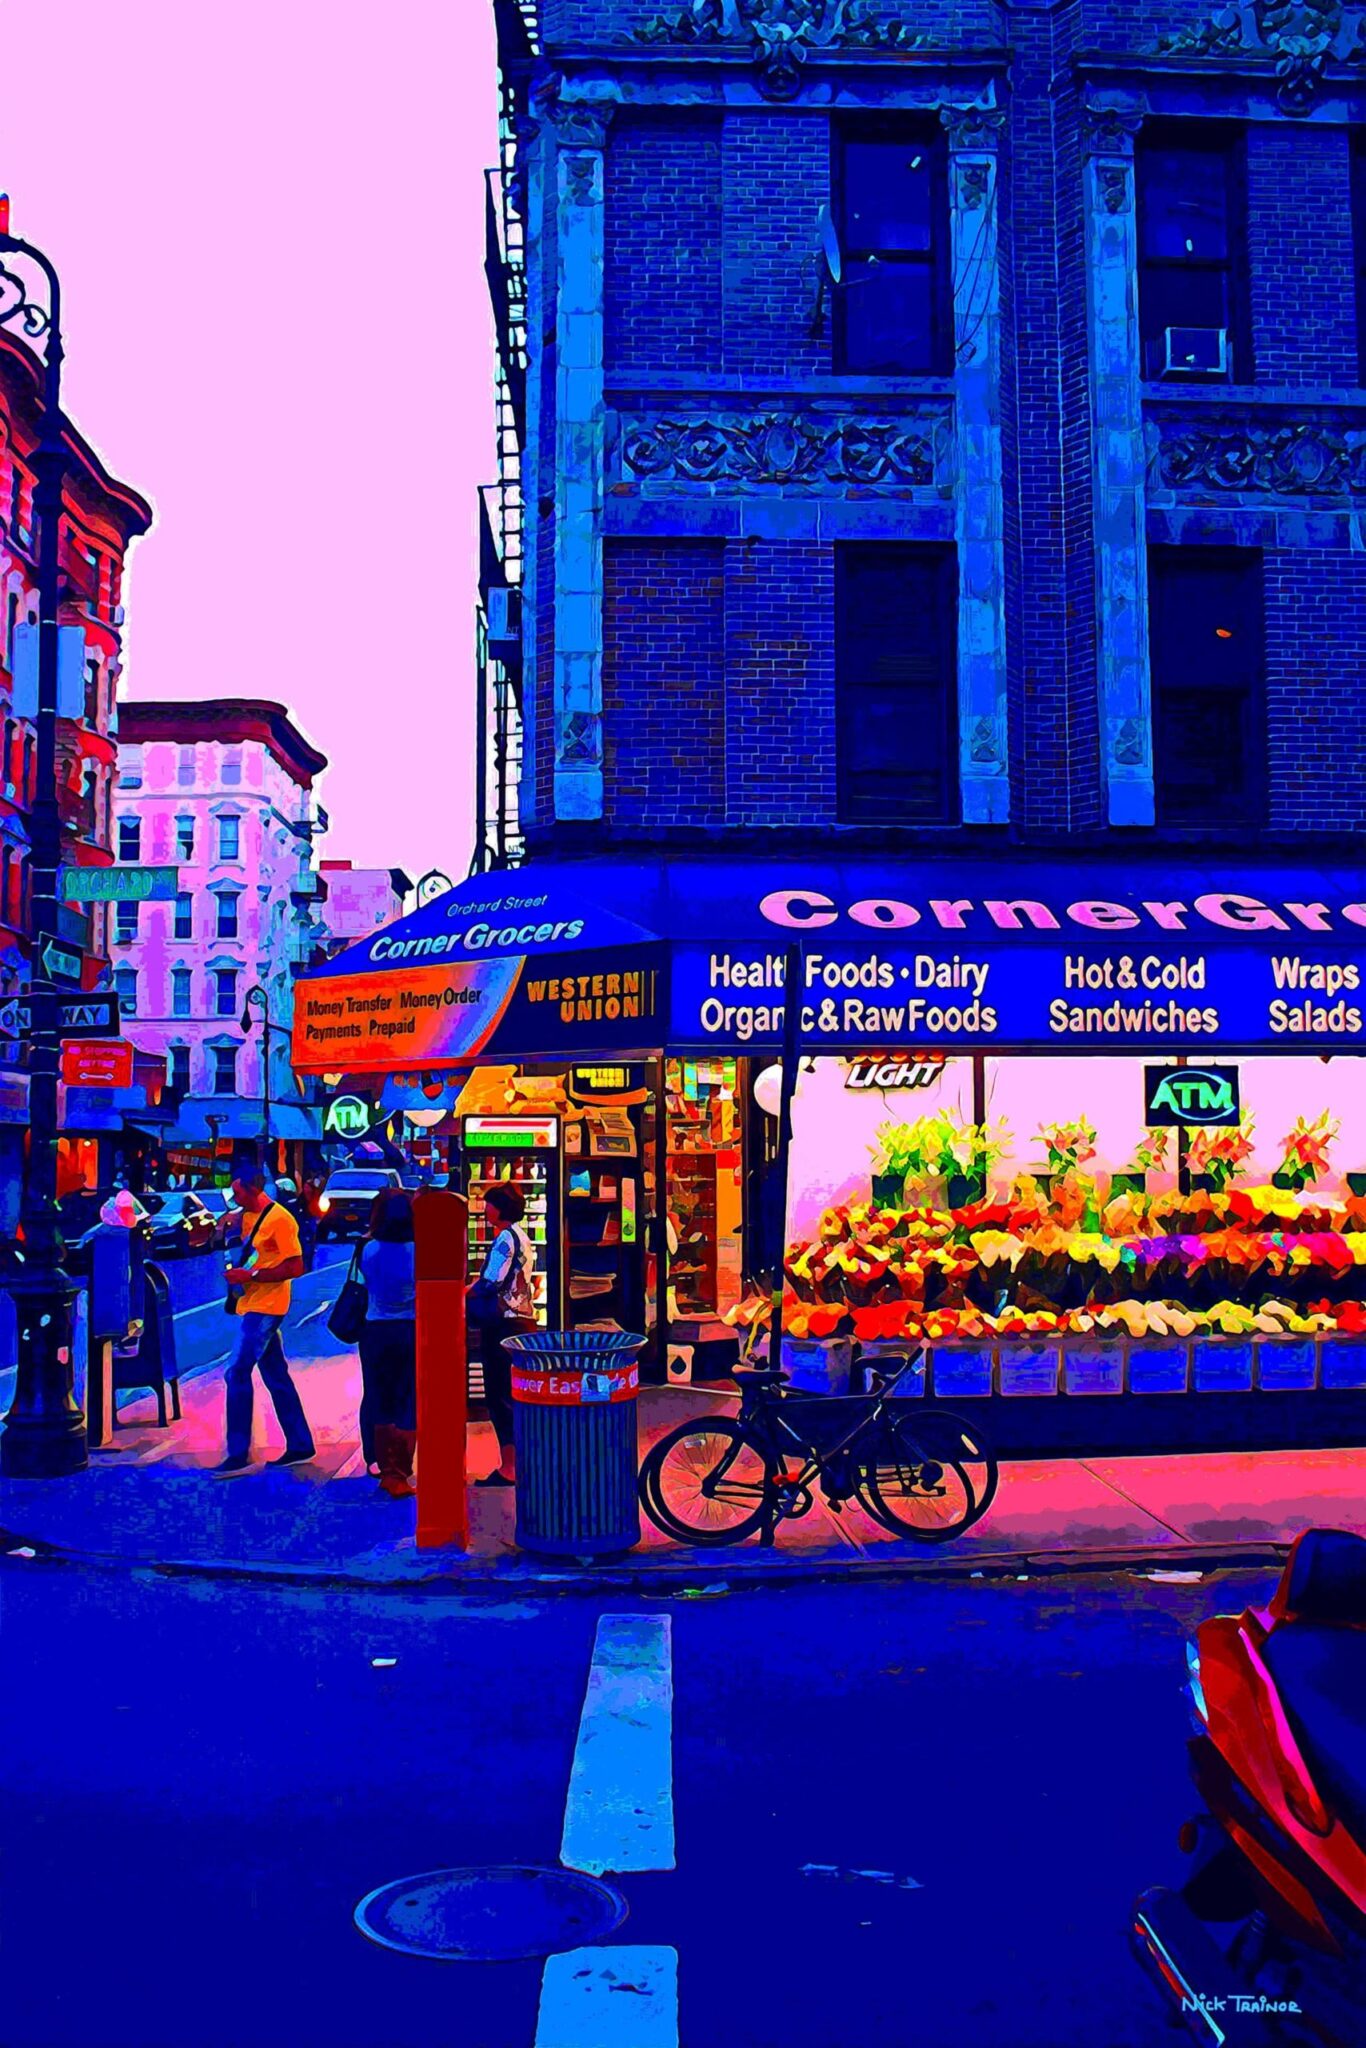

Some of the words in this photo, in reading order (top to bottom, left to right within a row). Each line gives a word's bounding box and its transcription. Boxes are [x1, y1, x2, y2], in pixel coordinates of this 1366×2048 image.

[66, 871, 153, 895] ORCHARD
[447, 898, 501, 917] Orchard
[503, 894, 548, 910] Street
[369, 932, 461, 961] Corner
[464, 919, 585, 950] Grocers
[527, 971, 639, 1002] WESTERN
[711, 955, 787, 987] Healt
[806, 955, 894, 987] Foods
[915, 955, 989, 996] Dairy
[1271, 957, 1359, 997] Wraps
[307, 1000, 344, 1017] Money
[346, 994, 392, 1013] Transfer
[400, 992, 443, 1009] Money
[444, 986, 482, 1005] Order
[560, 996, 639, 1023] UNION
[62, 1007, 99, 1025] WAY
[306, 1024, 361, 1042] Payments
[369, 1017, 415, 1037] Prepaid
[701, 998, 815, 1040] Organc
[1050, 999, 1218, 1033] Sandwiches
[1269, 1000, 1362, 1033] Salads
[846, 1063, 943, 1087] LIGHT
[1150, 1082, 1235, 1108] ATM
[324, 1104, 369, 1130] ATM
[549, 1377, 580, 1393] Eas
